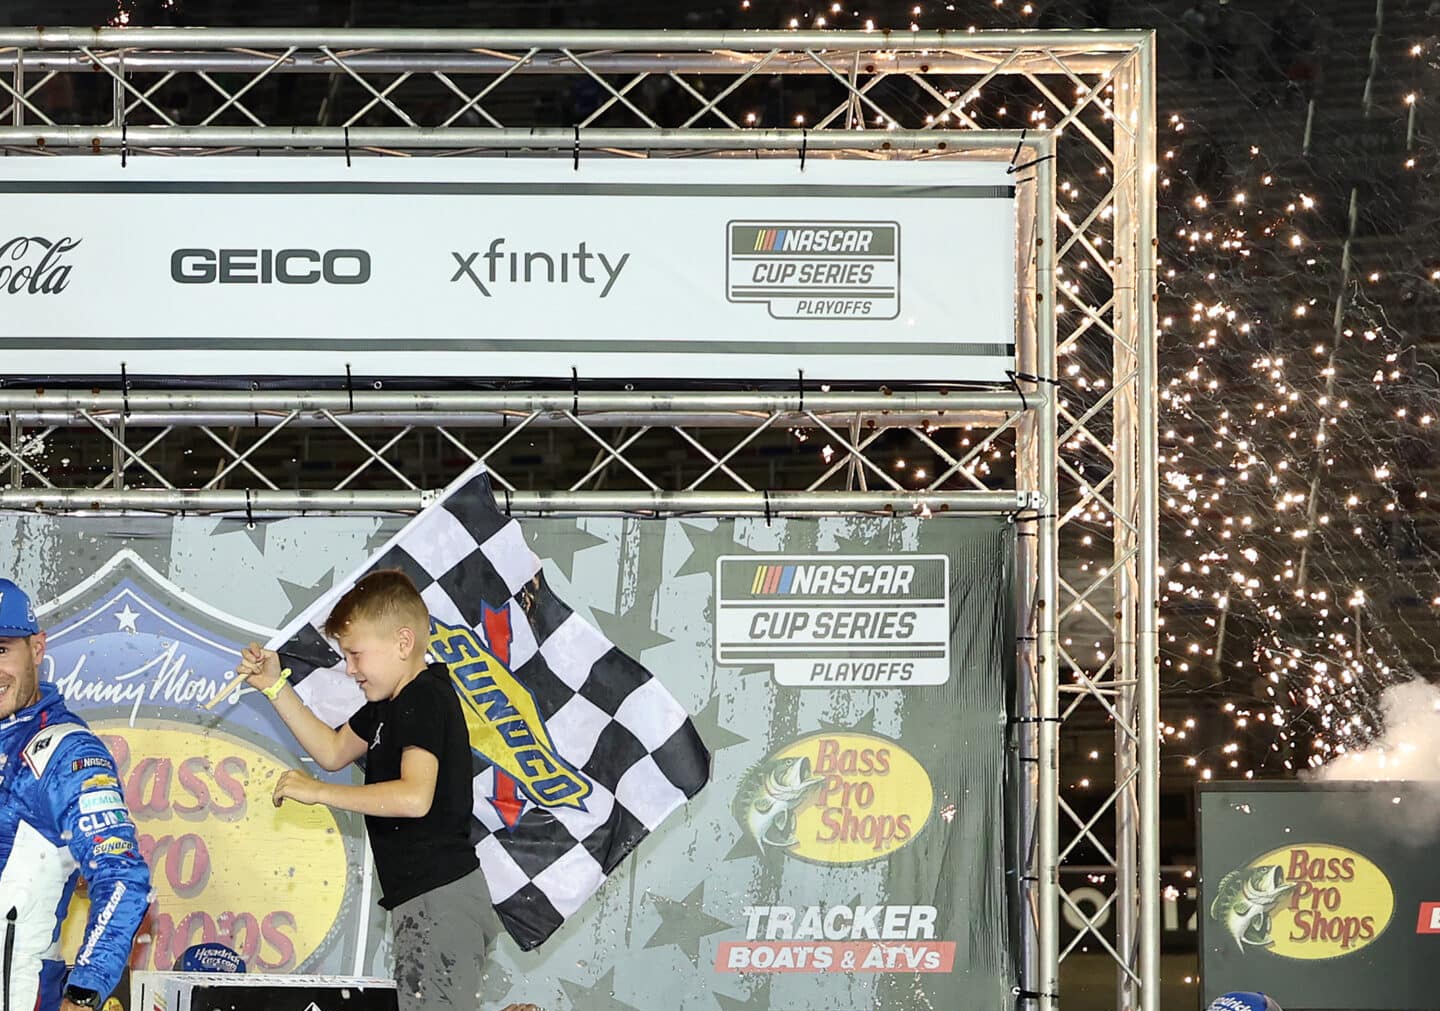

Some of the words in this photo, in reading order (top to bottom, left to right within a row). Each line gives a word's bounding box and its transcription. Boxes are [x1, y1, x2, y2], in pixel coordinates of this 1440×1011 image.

[779, 229, 875, 252] NASCAR
[169, 248, 372, 285] GEICO
[449, 237, 631, 298] xfinity
[750, 262, 795, 285] CUP
[799, 262, 875, 285] SERIES
[795, 299, 874, 315] PLAYOFFS
[789, 565, 916, 594] NASCAR
[748, 611, 810, 639] CUP
[812, 611, 918, 639] SERIES
[810, 663, 915, 681] PLAYOFFS
[433, 629, 580, 803] SUNOCO
[812, 738, 892, 774] Bass
[814, 774, 875, 808] Pro
[815, 807, 913, 849] Shops
[140, 832, 212, 900] ro
[1285, 849, 1356, 882] Bass
[1288, 880, 1342, 911] Pro
[741, 905, 939, 941] TRACKER
[1289, 909, 1376, 949] Shops
[727, 946, 834, 969] BOATS
[840, 950, 855, 970] &
[860, 946, 941, 969] ATVs
